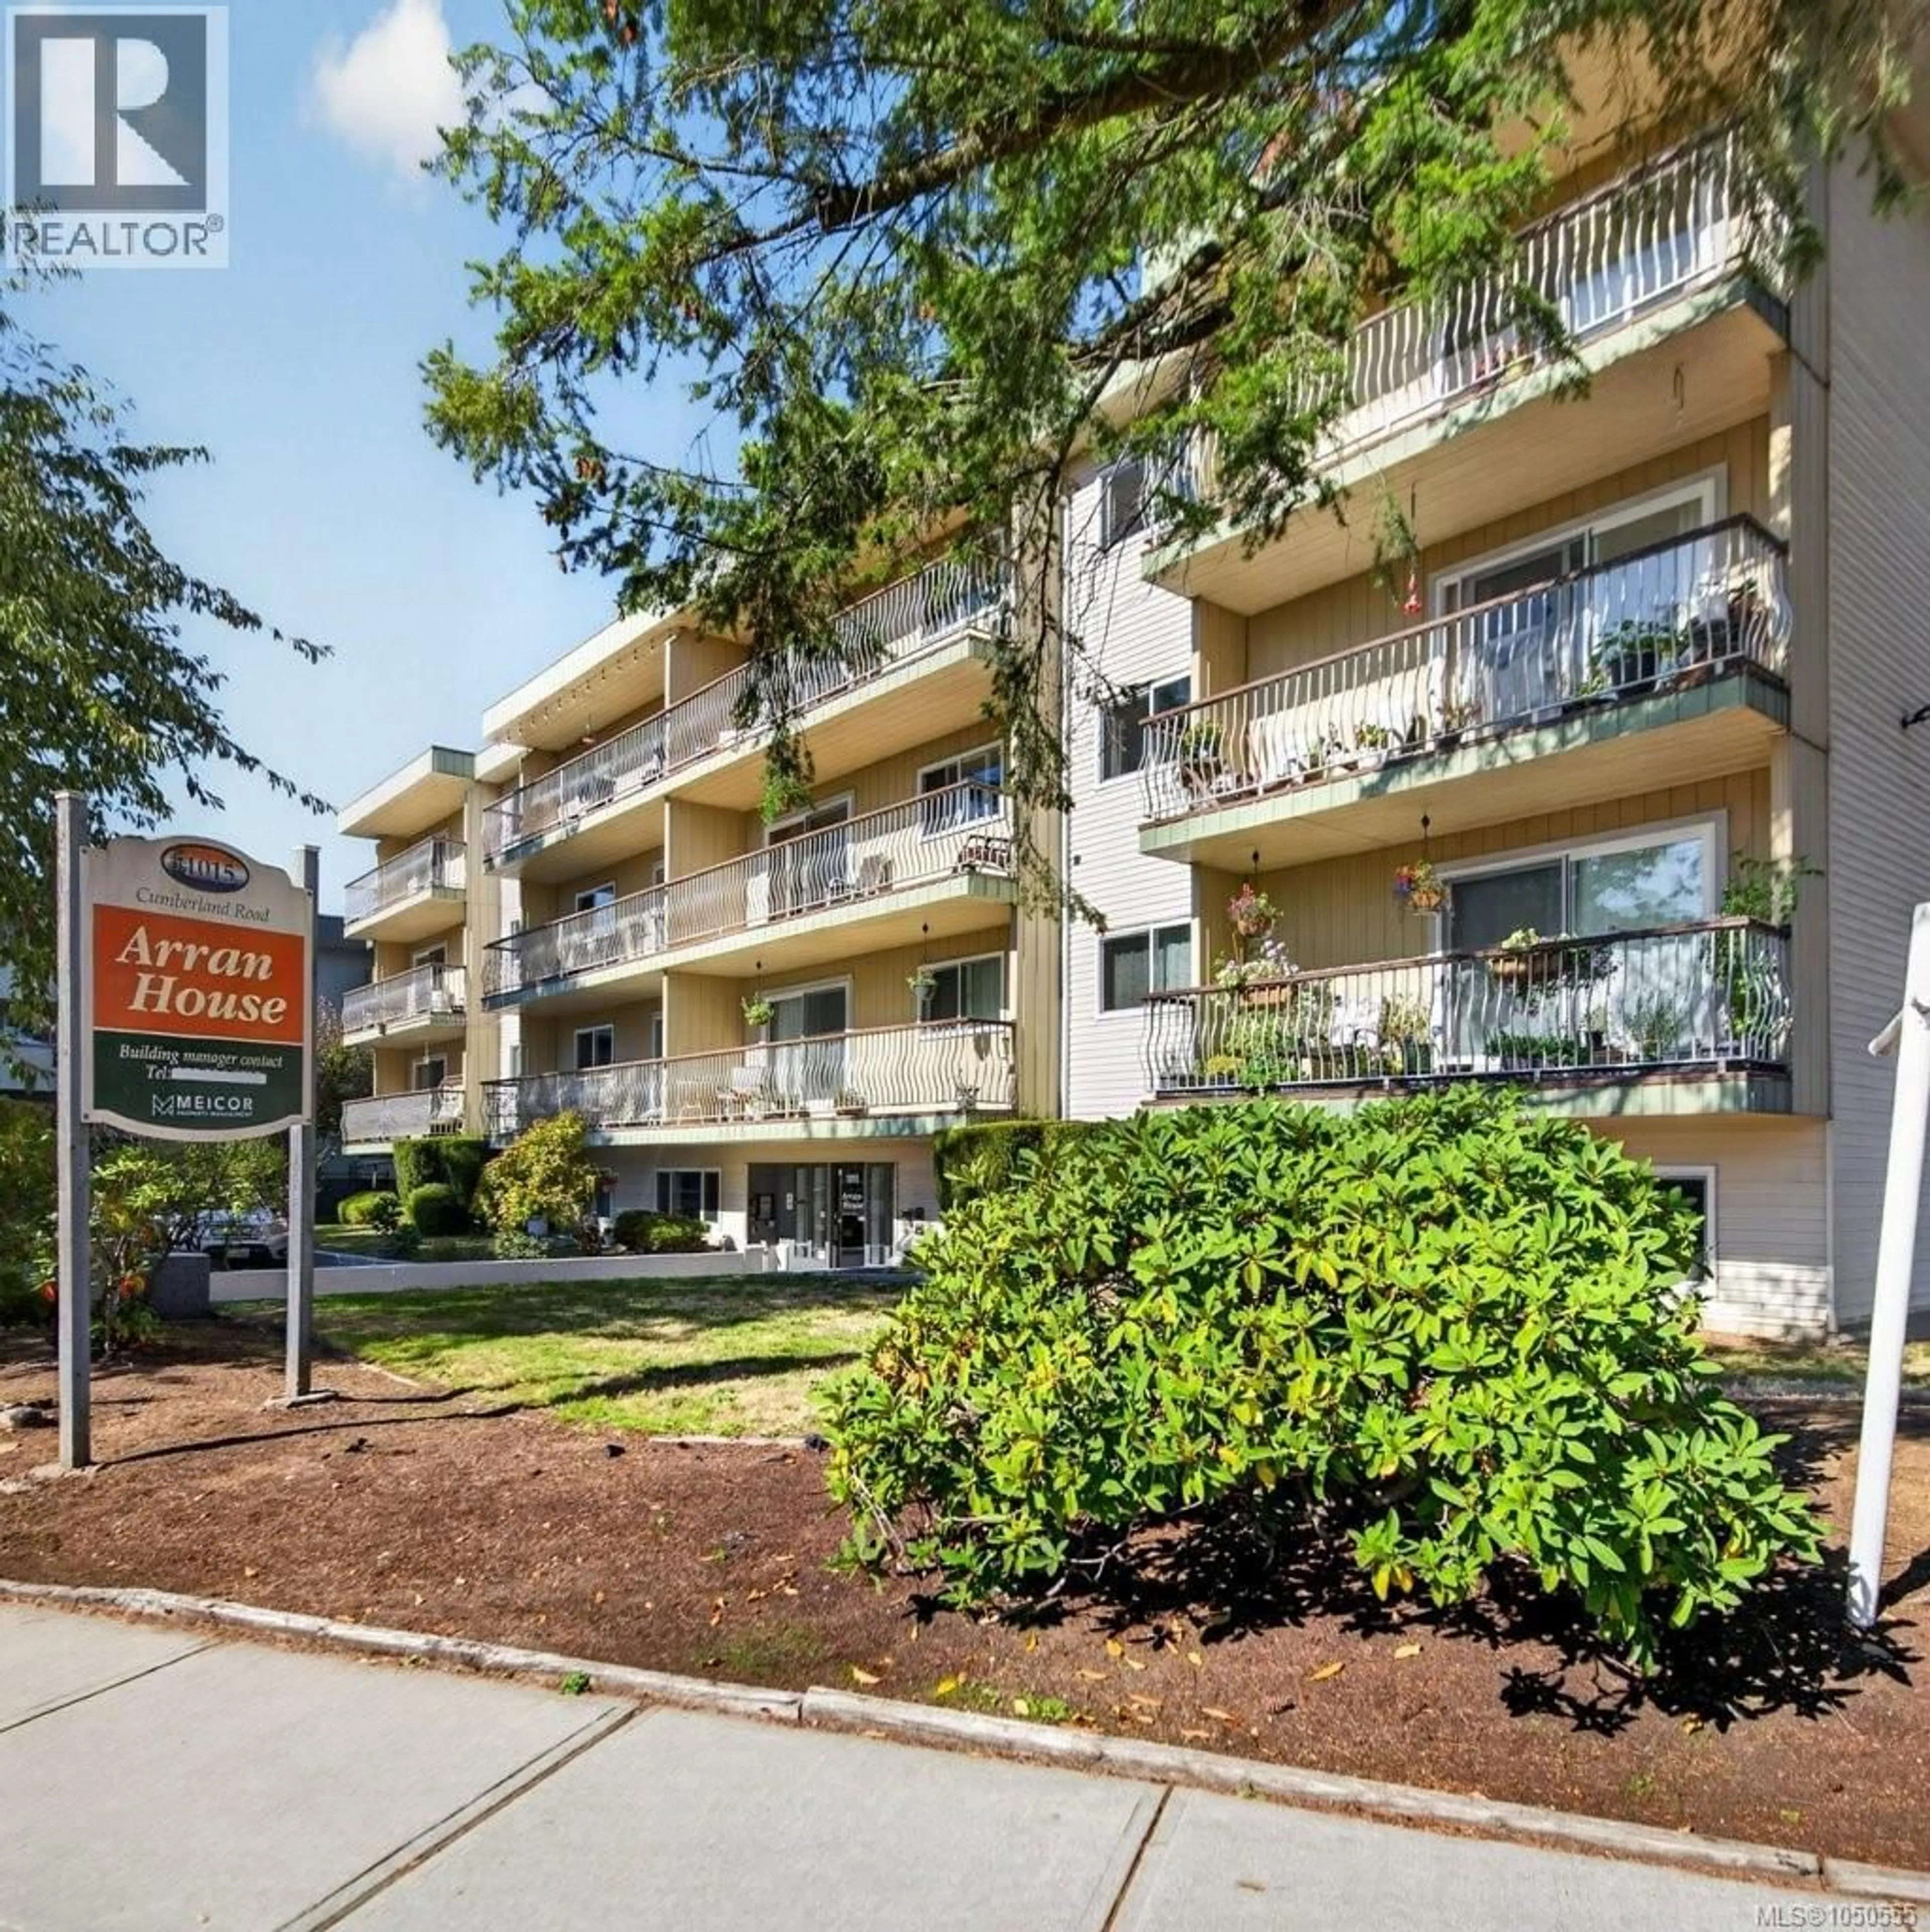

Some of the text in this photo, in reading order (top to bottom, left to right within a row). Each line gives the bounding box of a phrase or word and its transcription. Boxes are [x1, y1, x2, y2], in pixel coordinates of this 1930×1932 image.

[136, 887, 270, 922] Cumberland Road
[115, 926, 272, 981] Arran
[128, 973, 287, 1024] House
[119, 1044, 283, 1068] Building manager contact
[177, 1095, 253, 1110] MEICOR
